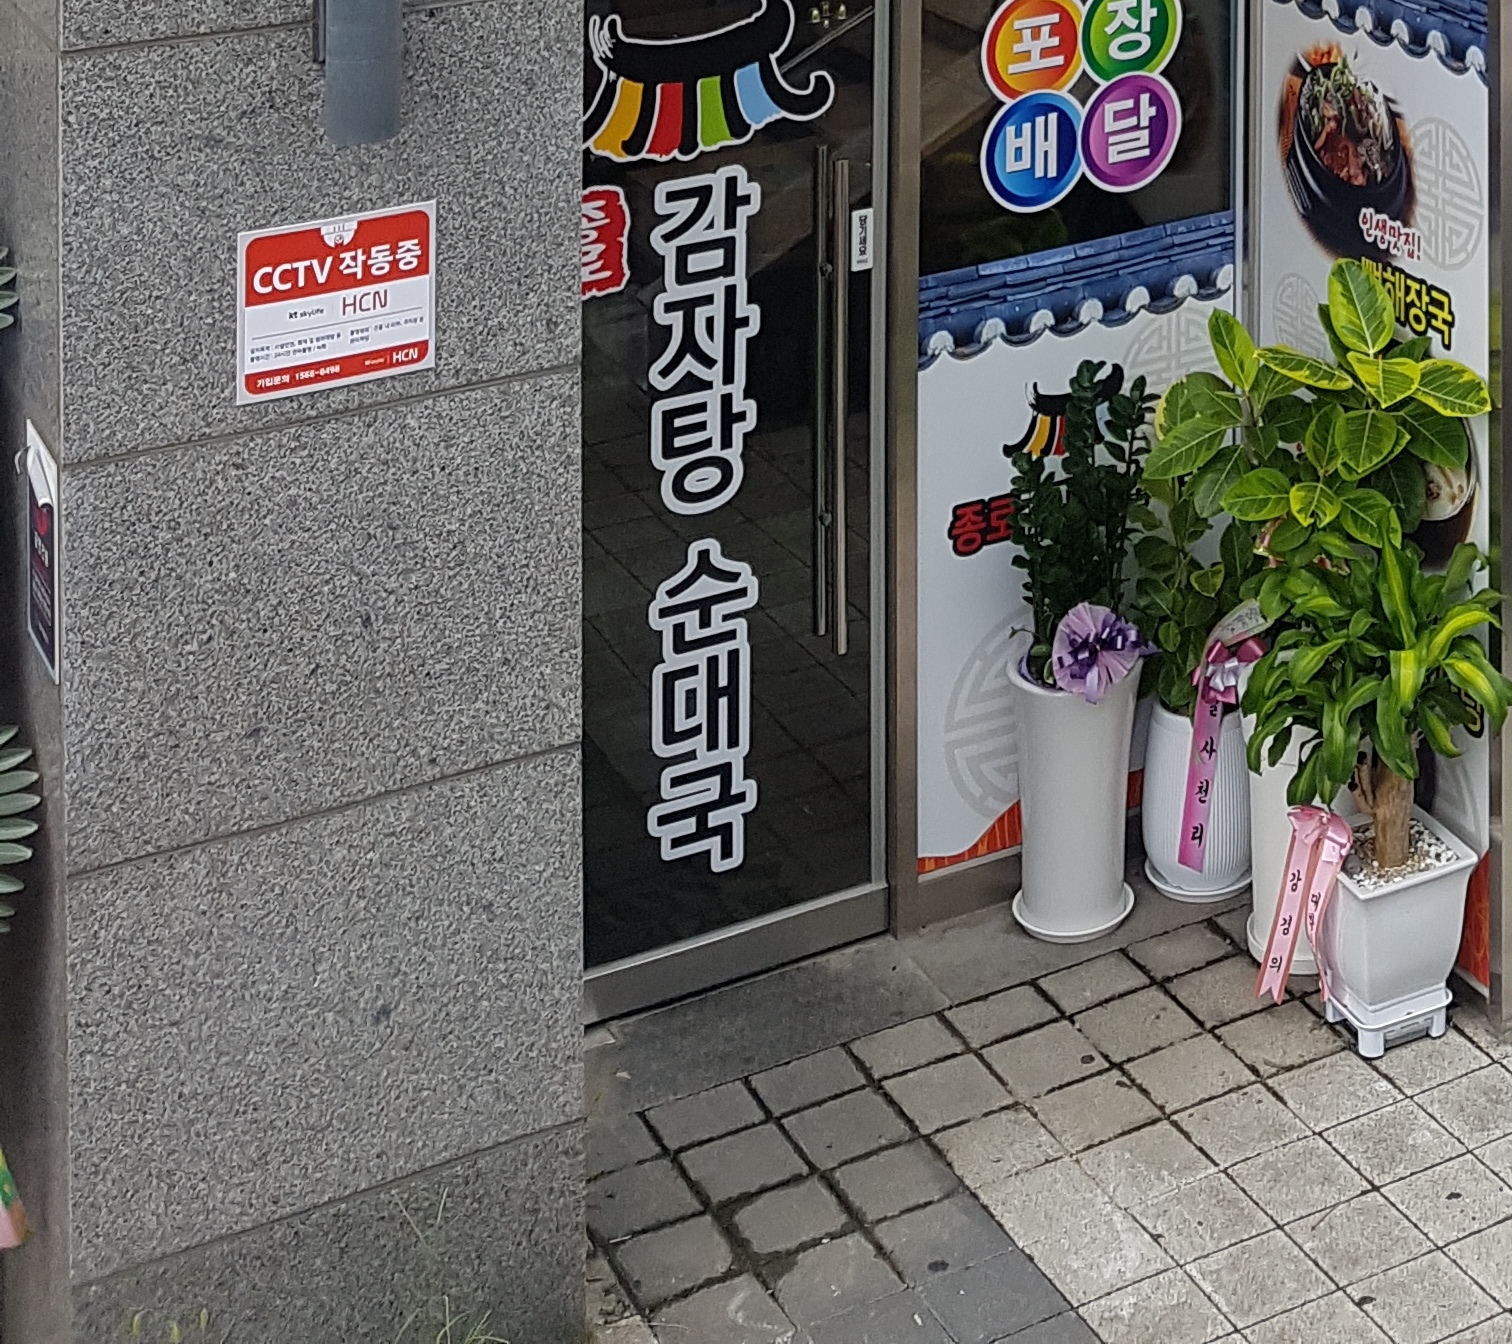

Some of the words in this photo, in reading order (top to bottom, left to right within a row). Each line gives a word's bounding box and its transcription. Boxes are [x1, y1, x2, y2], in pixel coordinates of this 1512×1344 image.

[253, 256, 333, 295] CCTV
[338, 238, 423, 280] 작동중
[342, 288, 388, 316] HCN
[392, 347, 419, 364] HCN
[652, 170, 758, 509] 감자탕
[651, 543, 753, 867] 순대국
